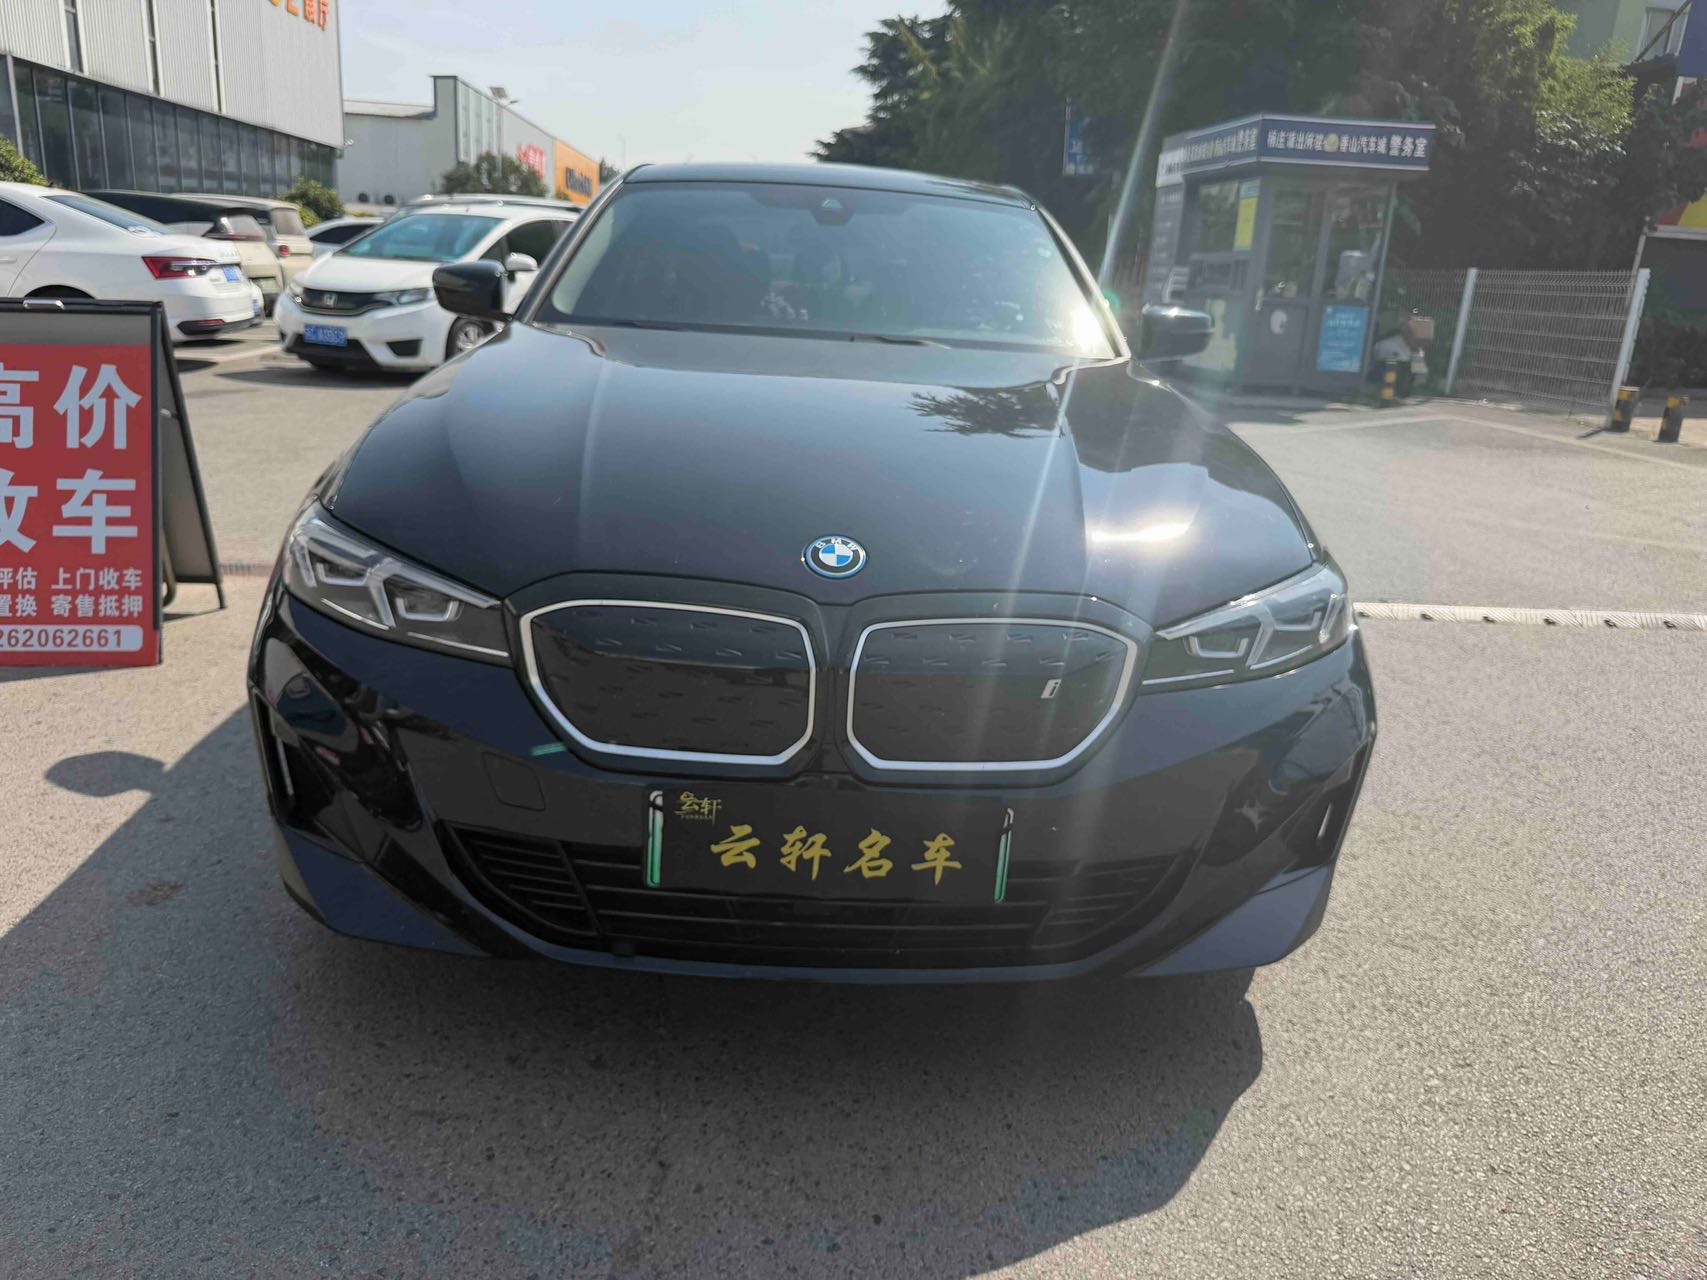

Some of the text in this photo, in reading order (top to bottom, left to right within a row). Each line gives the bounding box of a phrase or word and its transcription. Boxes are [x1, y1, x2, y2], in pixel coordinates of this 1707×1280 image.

[51, 567, 143, 591] 上门收车
[51, 594, 143, 618] 寄售抵押
[0, 628, 121, 648] 62062661
[710, 824, 962, 886] 云轩名车
